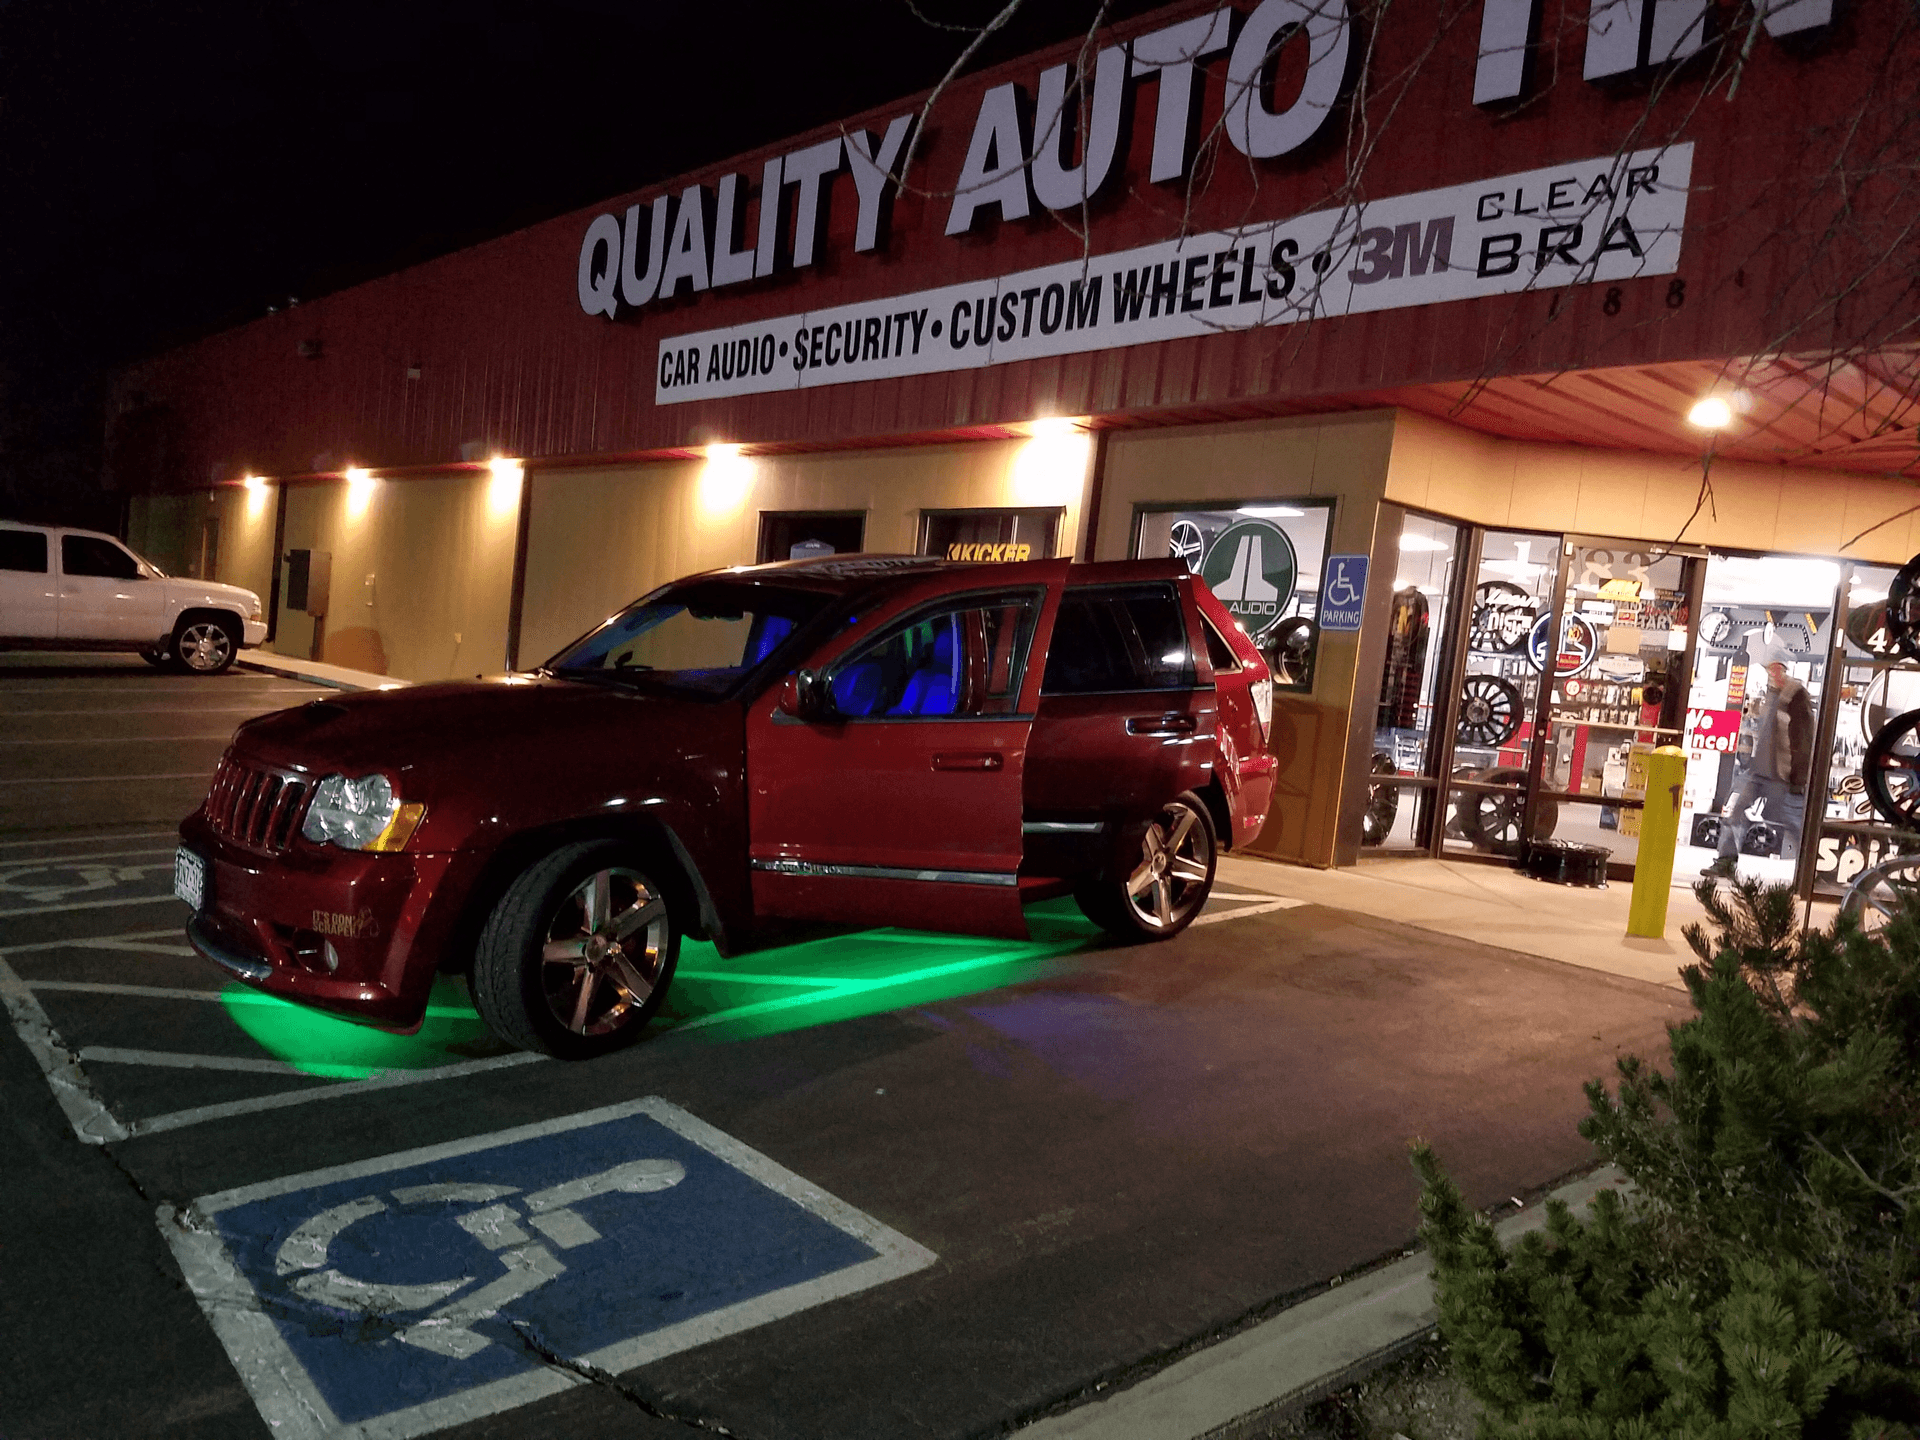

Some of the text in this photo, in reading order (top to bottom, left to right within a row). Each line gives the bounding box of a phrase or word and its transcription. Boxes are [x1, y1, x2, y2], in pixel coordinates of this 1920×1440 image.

[577, 113, 914, 321] QUALITY
[945, 0, 1350, 237] AUTO
[1477, 165, 1660, 223] CLEAR
[1477, 216, 1644, 279] BRA
[660, 216, 1455, 389] CAR AUDIO SECURITY CUSTOM WHEELS 3M
[960, 543, 1031, 562] KICKER
[1228, 601, 1277, 615] AUDIO
[1322, 609, 1360, 625] PARKING
